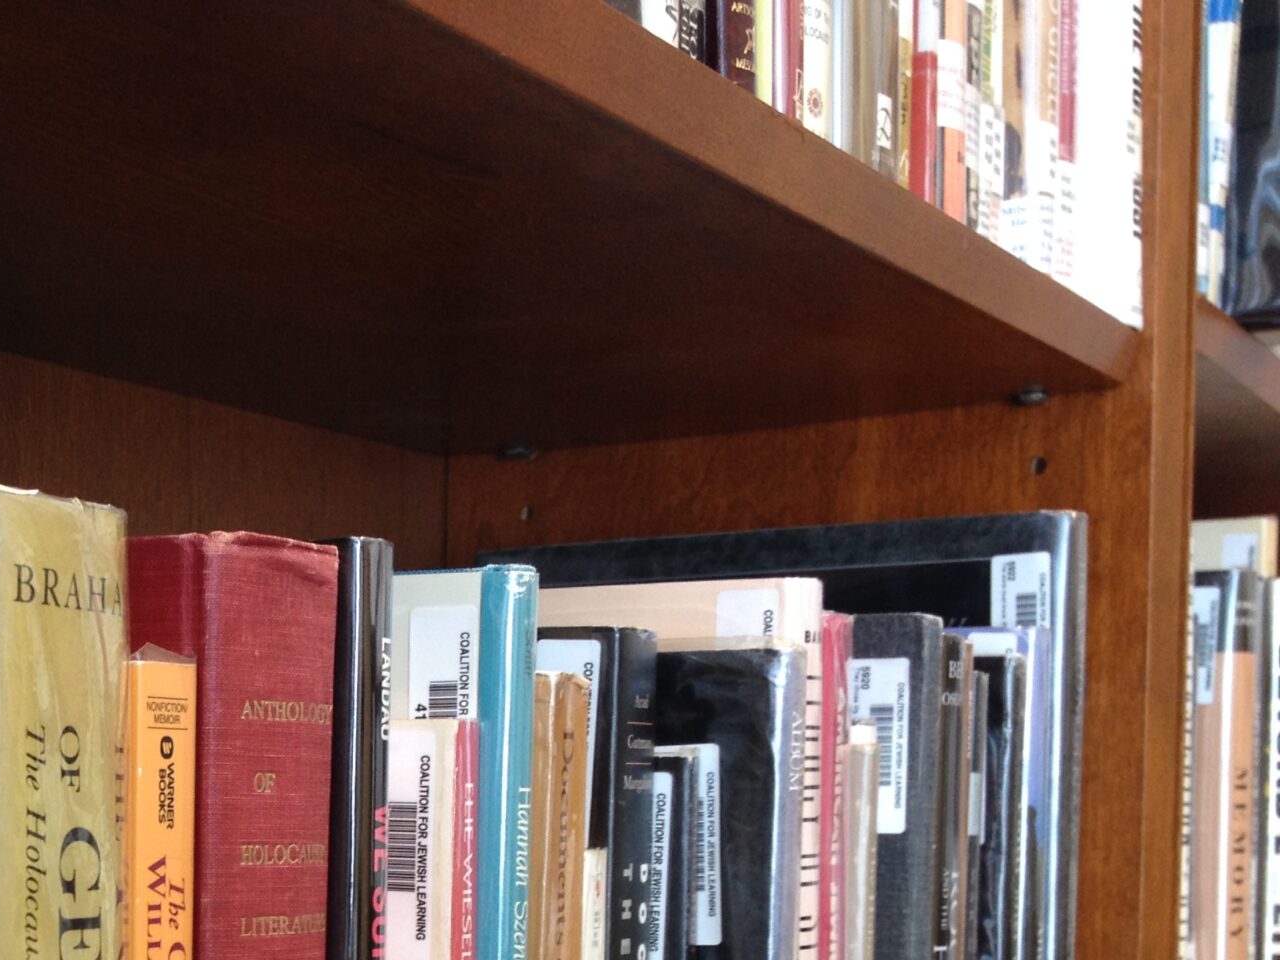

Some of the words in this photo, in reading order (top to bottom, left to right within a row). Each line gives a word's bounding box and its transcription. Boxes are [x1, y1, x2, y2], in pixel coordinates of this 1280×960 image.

[459, 631, 471, 692] COALITION
[380, 636, 392, 742] LANDAU
[458, 692, 470, 718] FOR
[23, 725, 47, 791] The
[58, 725, 82, 794] OF
[253, 771, 276, 793] OF
[158, 768, 168, 826] BOOKS
[166, 761, 176, 830] WARNER
[417, 755, 431, 815] COALITION
[706, 771, 716, 818] COALITION
[417, 816, 430, 839] FOR
[463, 782, 474, 848] ELIE
[515, 787, 533, 887] Hannah
[555, 731, 575, 946] Documents
[654, 793, 667, 844] COALITION
[706, 819, 717, 838] FOR
[416, 840, 428, 883] JEWISH
[652, 845, 664, 866] FOR
[706, 839, 716, 872] JEWISH
[1230, 768, 1249, 939] MEMORY
[168, 878, 187, 930] The
[651, 866, 663, 902] JEWISH
[706, 873, 717, 918] LEARNING
[415, 885, 427, 941] LEARNING
[649, 904, 661, 953] LEARNING
